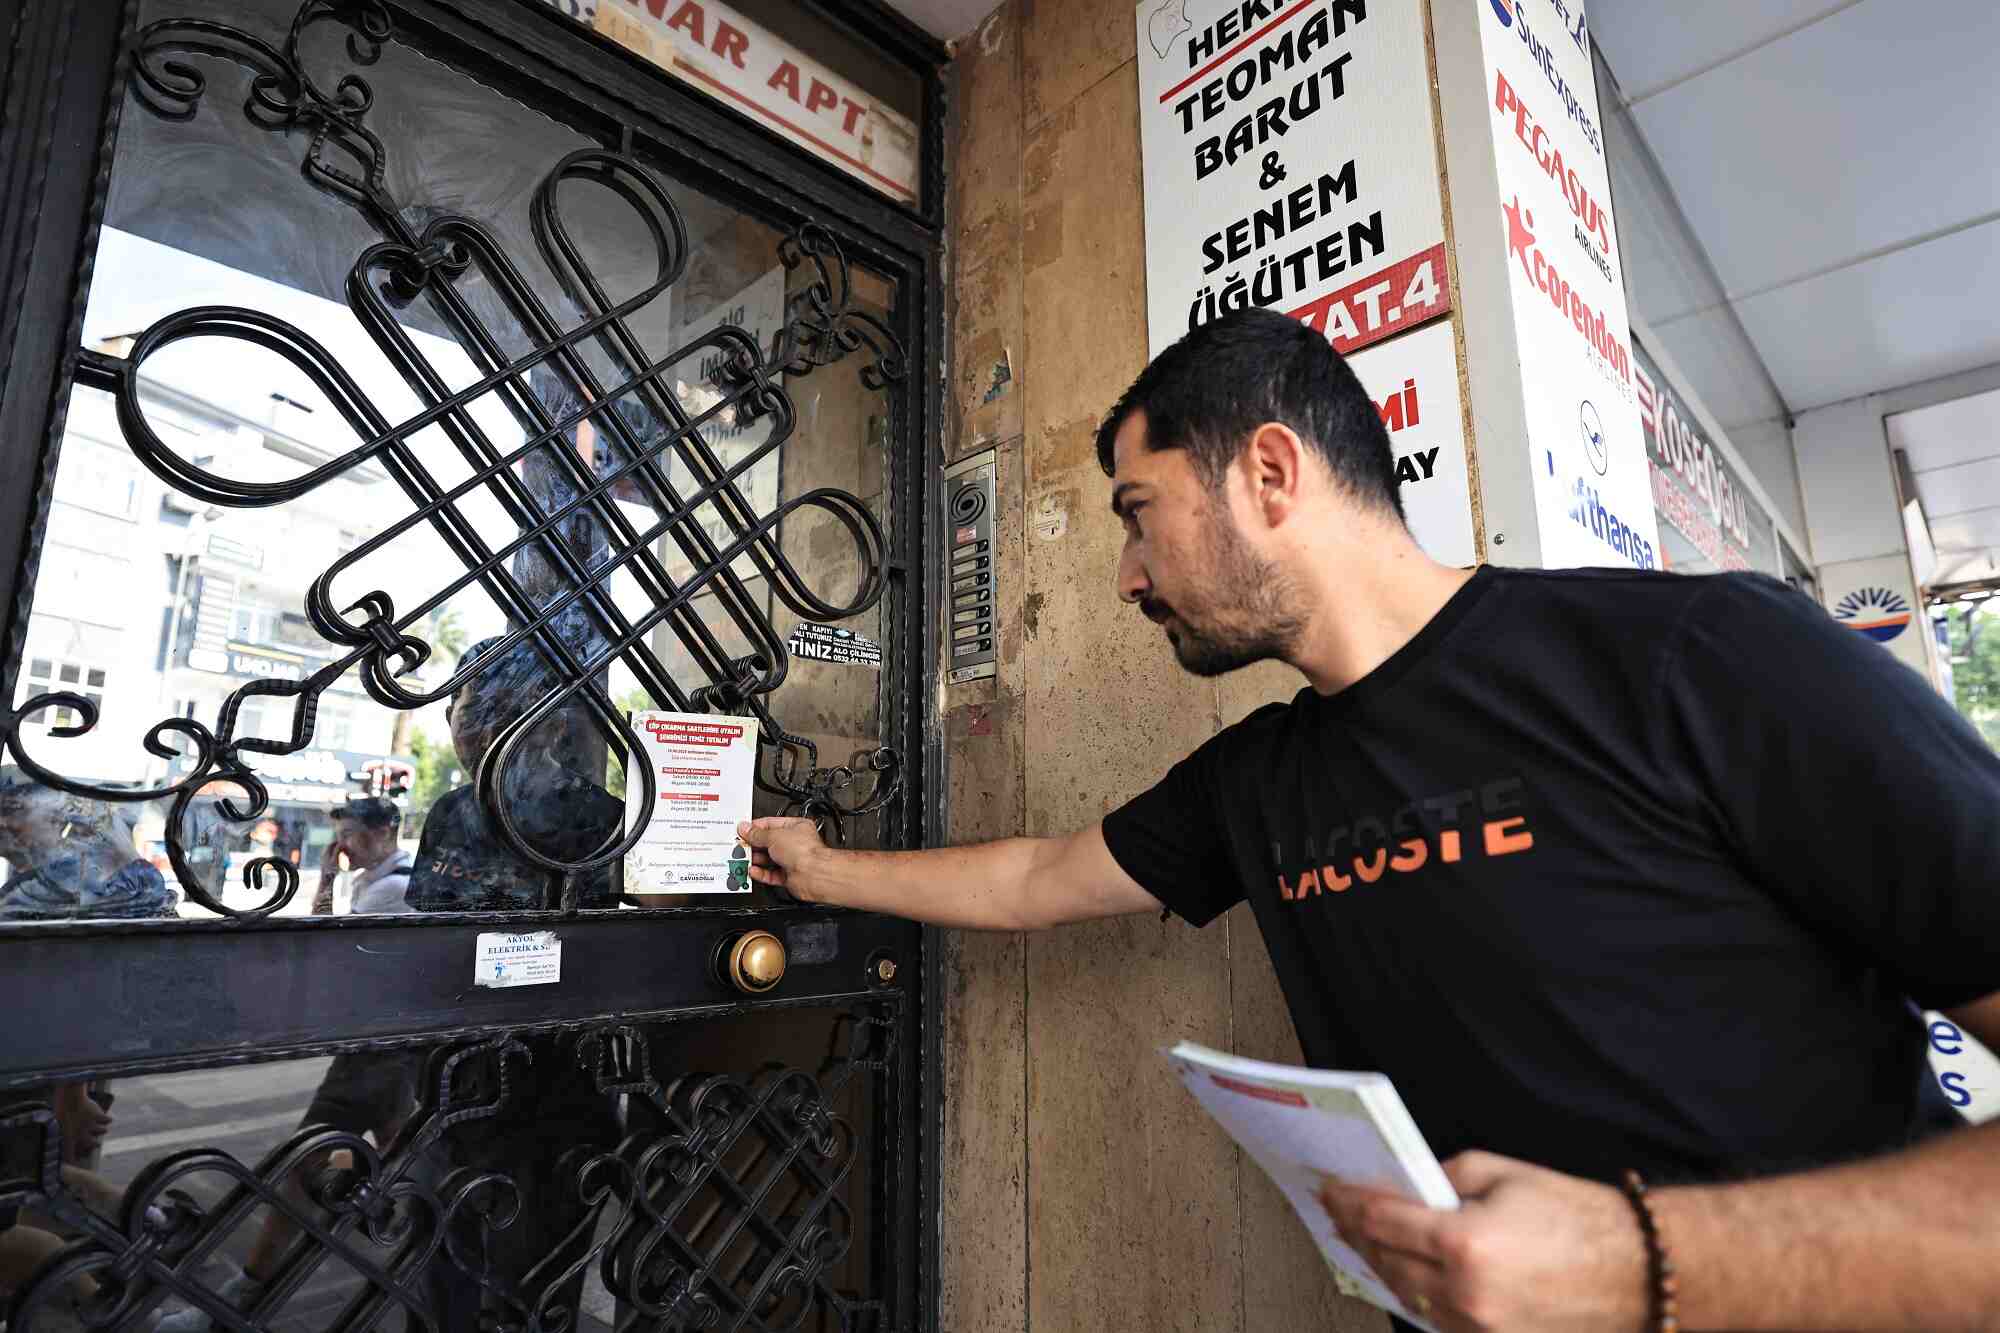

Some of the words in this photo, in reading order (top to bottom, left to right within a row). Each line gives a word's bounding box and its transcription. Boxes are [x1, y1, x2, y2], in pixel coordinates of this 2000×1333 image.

[1174, 0, 1367, 134] TEOMAN
[1188, 0, 1284, 69] HEK
[1515, 1, 1601, 154] SunExpress
[1194, 51, 1353, 181] BARUT
[1259, 150, 1287, 190] &
[1495, 67, 1609, 254] PEGASUS
[1188, 210, 1385, 333] ÜĞÜTEN
[1201, 159, 1358, 276] SENEM
[1574, 223, 1613, 283] AIRLINES
[1533, 248, 1631, 385] corendon
[1271, 778, 1534, 901] LACOSTE
